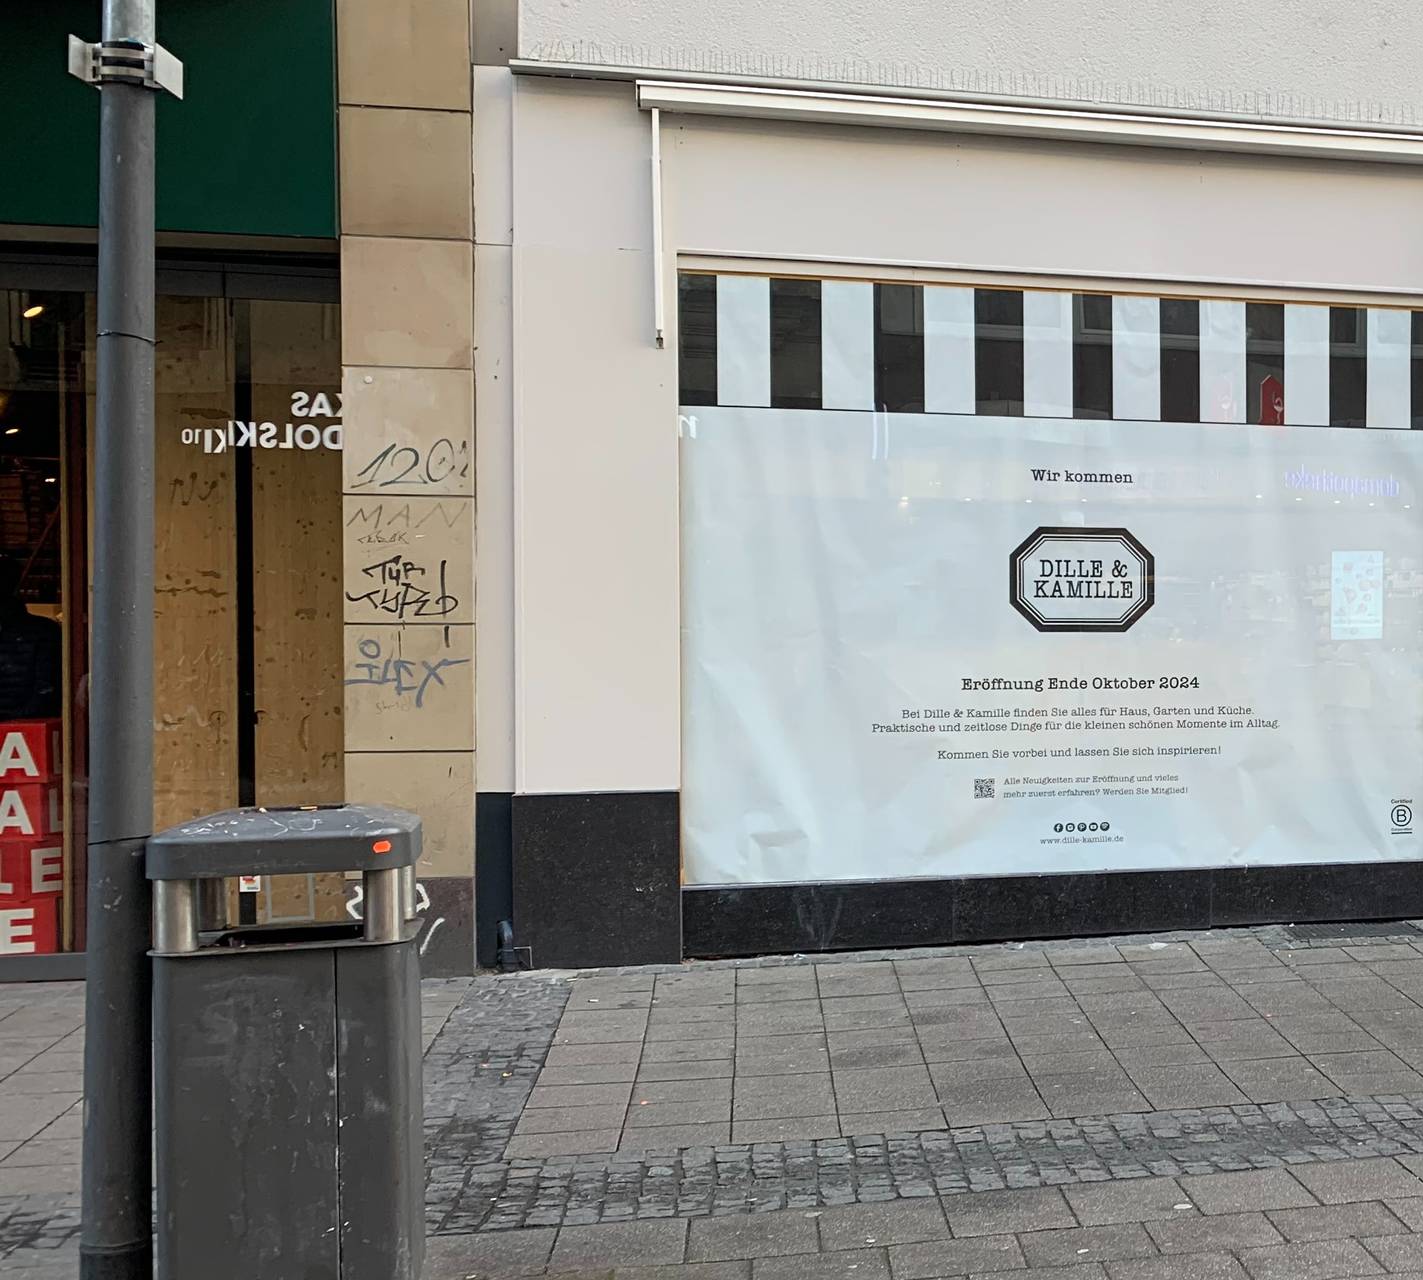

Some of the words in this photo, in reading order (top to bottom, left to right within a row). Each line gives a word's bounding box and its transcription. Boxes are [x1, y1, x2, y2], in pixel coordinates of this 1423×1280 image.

[1031, 469, 1060, 482] Wir
[1064, 470, 1133, 483] kommen
[1039, 559, 1103, 578] DILLE
[1111, 559, 1128, 578] &
[1033, 580, 1133, 599] KAMILLE
[961, 678, 1044, 692] Eröffnung
[1047, 677, 1088, 690] Ende
[1092, 677, 1155, 690] Oktober
[1159, 676, 1200, 689] 2024
[902, 709, 920, 719] Bei
[924, 709, 951, 719] Dille
[953, 709, 963, 719] &
[966, 708, 1011, 718] Kamille
[1013, 708, 1048, 718] finden
[1051, 707, 1069, 717] Sie
[1071, 707, 1097, 717] alles
[1100, 707, 1117, 717] für
[1119, 707, 1151, 718] Haus,
[1153, 706, 1191, 716] Garten
[1193, 706, 1214, 716] und
[1217, 706, 1255, 716] Küche.
[871, 723, 936, 733] Praktische
[938, 722, 961, 732] und
[964, 722, 1007, 732] zeitlose
[1010, 722, 1042, 733] Dinge
[1045, 721, 1062, 731] für
[1064, 721, 1082, 731] die
[1084, 720, 1126, 730] kleinen
[1128, 720, 1174, 730] schönen
[1176, 719, 1227, 729] Momente
[1229, 719, 1244, 729] im
[937, 750, 989, 760] Kommen
[992, 749, 1009, 759] Sie
[1012, 748, 1048, 758] vorbei
[1050, 748, 1072, 758] und
[1074, 747, 1110, 757] lassen
[1112, 747, 1129, 757] Sie
[1132, 746, 1154, 756] sich
[1157, 745, 1221, 757] inspirieren!
[1003, 777, 1020, 785] Alle
[1022, 776, 1074, 786] Neuigkeiten
[1075, 776, 1090, 784] zur
[1092, 775, 1135, 784] Eröffnung
[1136, 775, 1153, 783] und
[1154, 774, 1179, 782] vieles
[1003, 790, 1026, 799] mehr
[1028, 790, 1055, 798] zuerst
[1057, 788, 1101, 798] erfahren?
[1102, 787, 1134, 796] Werden
[1135, 787, 1149, 795] Sie
[1151, 786, 1188, 796] Mitglied!
[1040, 834, 1124, 845] www.dille-kamille.de
